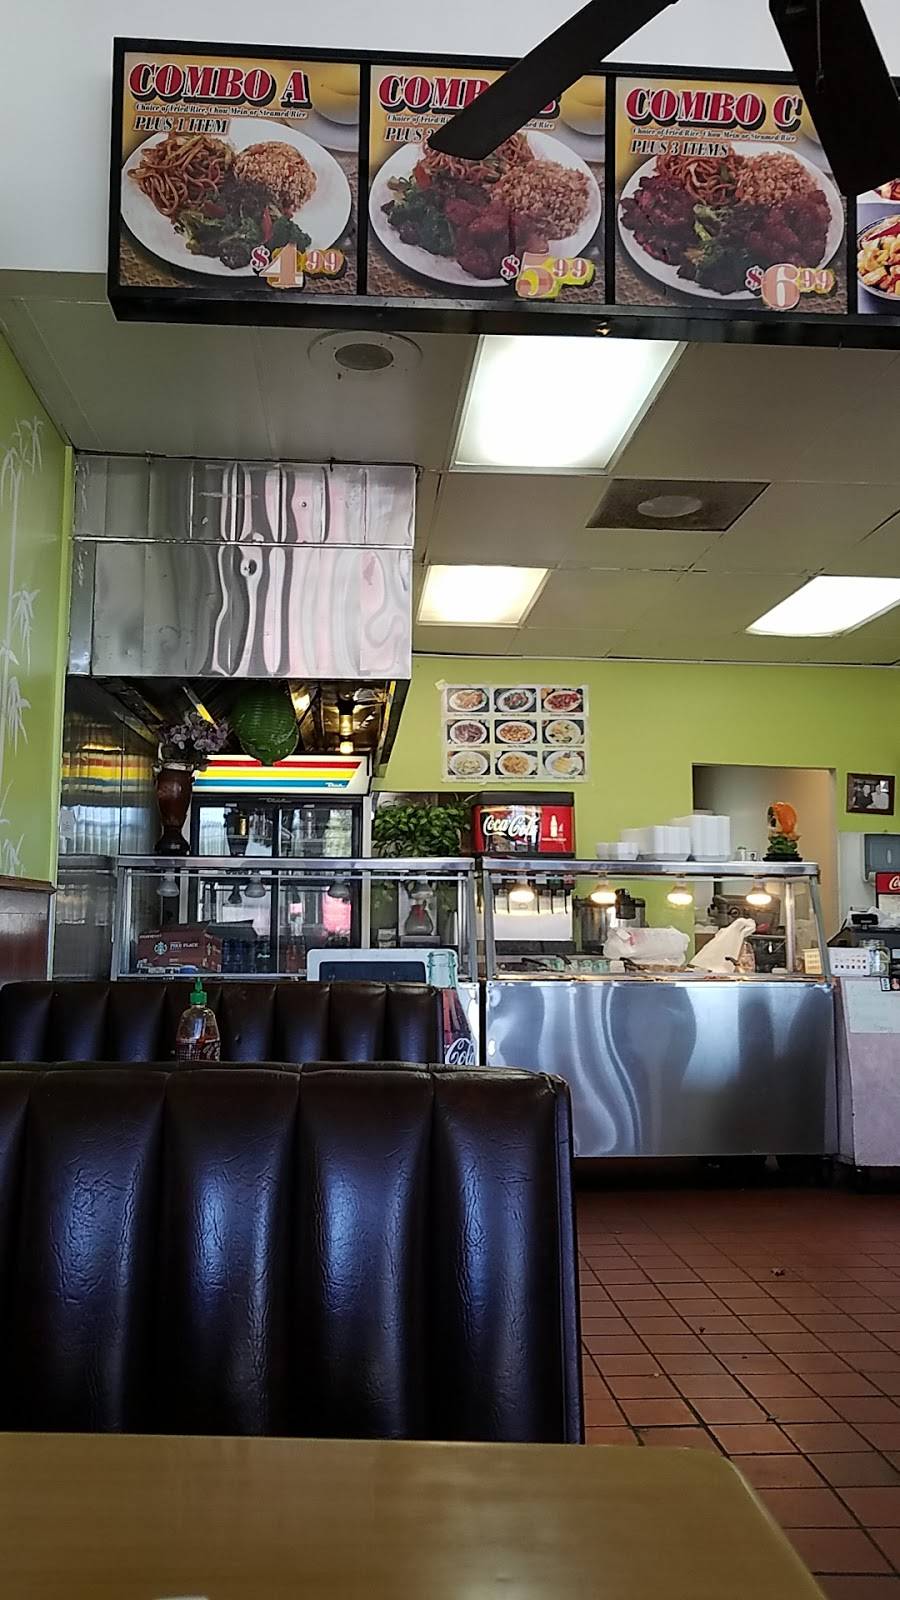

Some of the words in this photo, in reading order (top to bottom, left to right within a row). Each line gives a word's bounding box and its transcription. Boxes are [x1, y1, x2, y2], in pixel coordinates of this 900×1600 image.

[128, 63, 274, 104] COMBO
[280, 70, 311, 107] A
[136, 104, 159, 112] Choice
[161, 105, 169, 113] of
[168, 105, 190, 113] Fried
[209, 106, 229, 114] Chow
[230, 107, 248, 115] Mein
[258, 108, 290, 117] Steamed
[290, 110, 307, 118] Rice
[626, 88, 766, 128] COMBO
[774, 94, 801, 131] C
[135, 116, 173, 131] PLUS
[177, 118, 185, 132] 1
[189, 118, 229, 133] ITEM
[387, 114, 410, 122] Choice
[412, 115, 420, 124] of
[419, 115, 440, 123] Fried
[538, 121, 554, 129] Rice
[385, 127, 422, 141] PLUS
[633, 128, 655, 136] Choice
[657, 129, 664, 137] of
[664, 129, 684, 137] Fried
[632, 140, 668, 154] PLUS
[671, 141, 679, 154] 3
[683, 142, 729, 156] ITEMS
